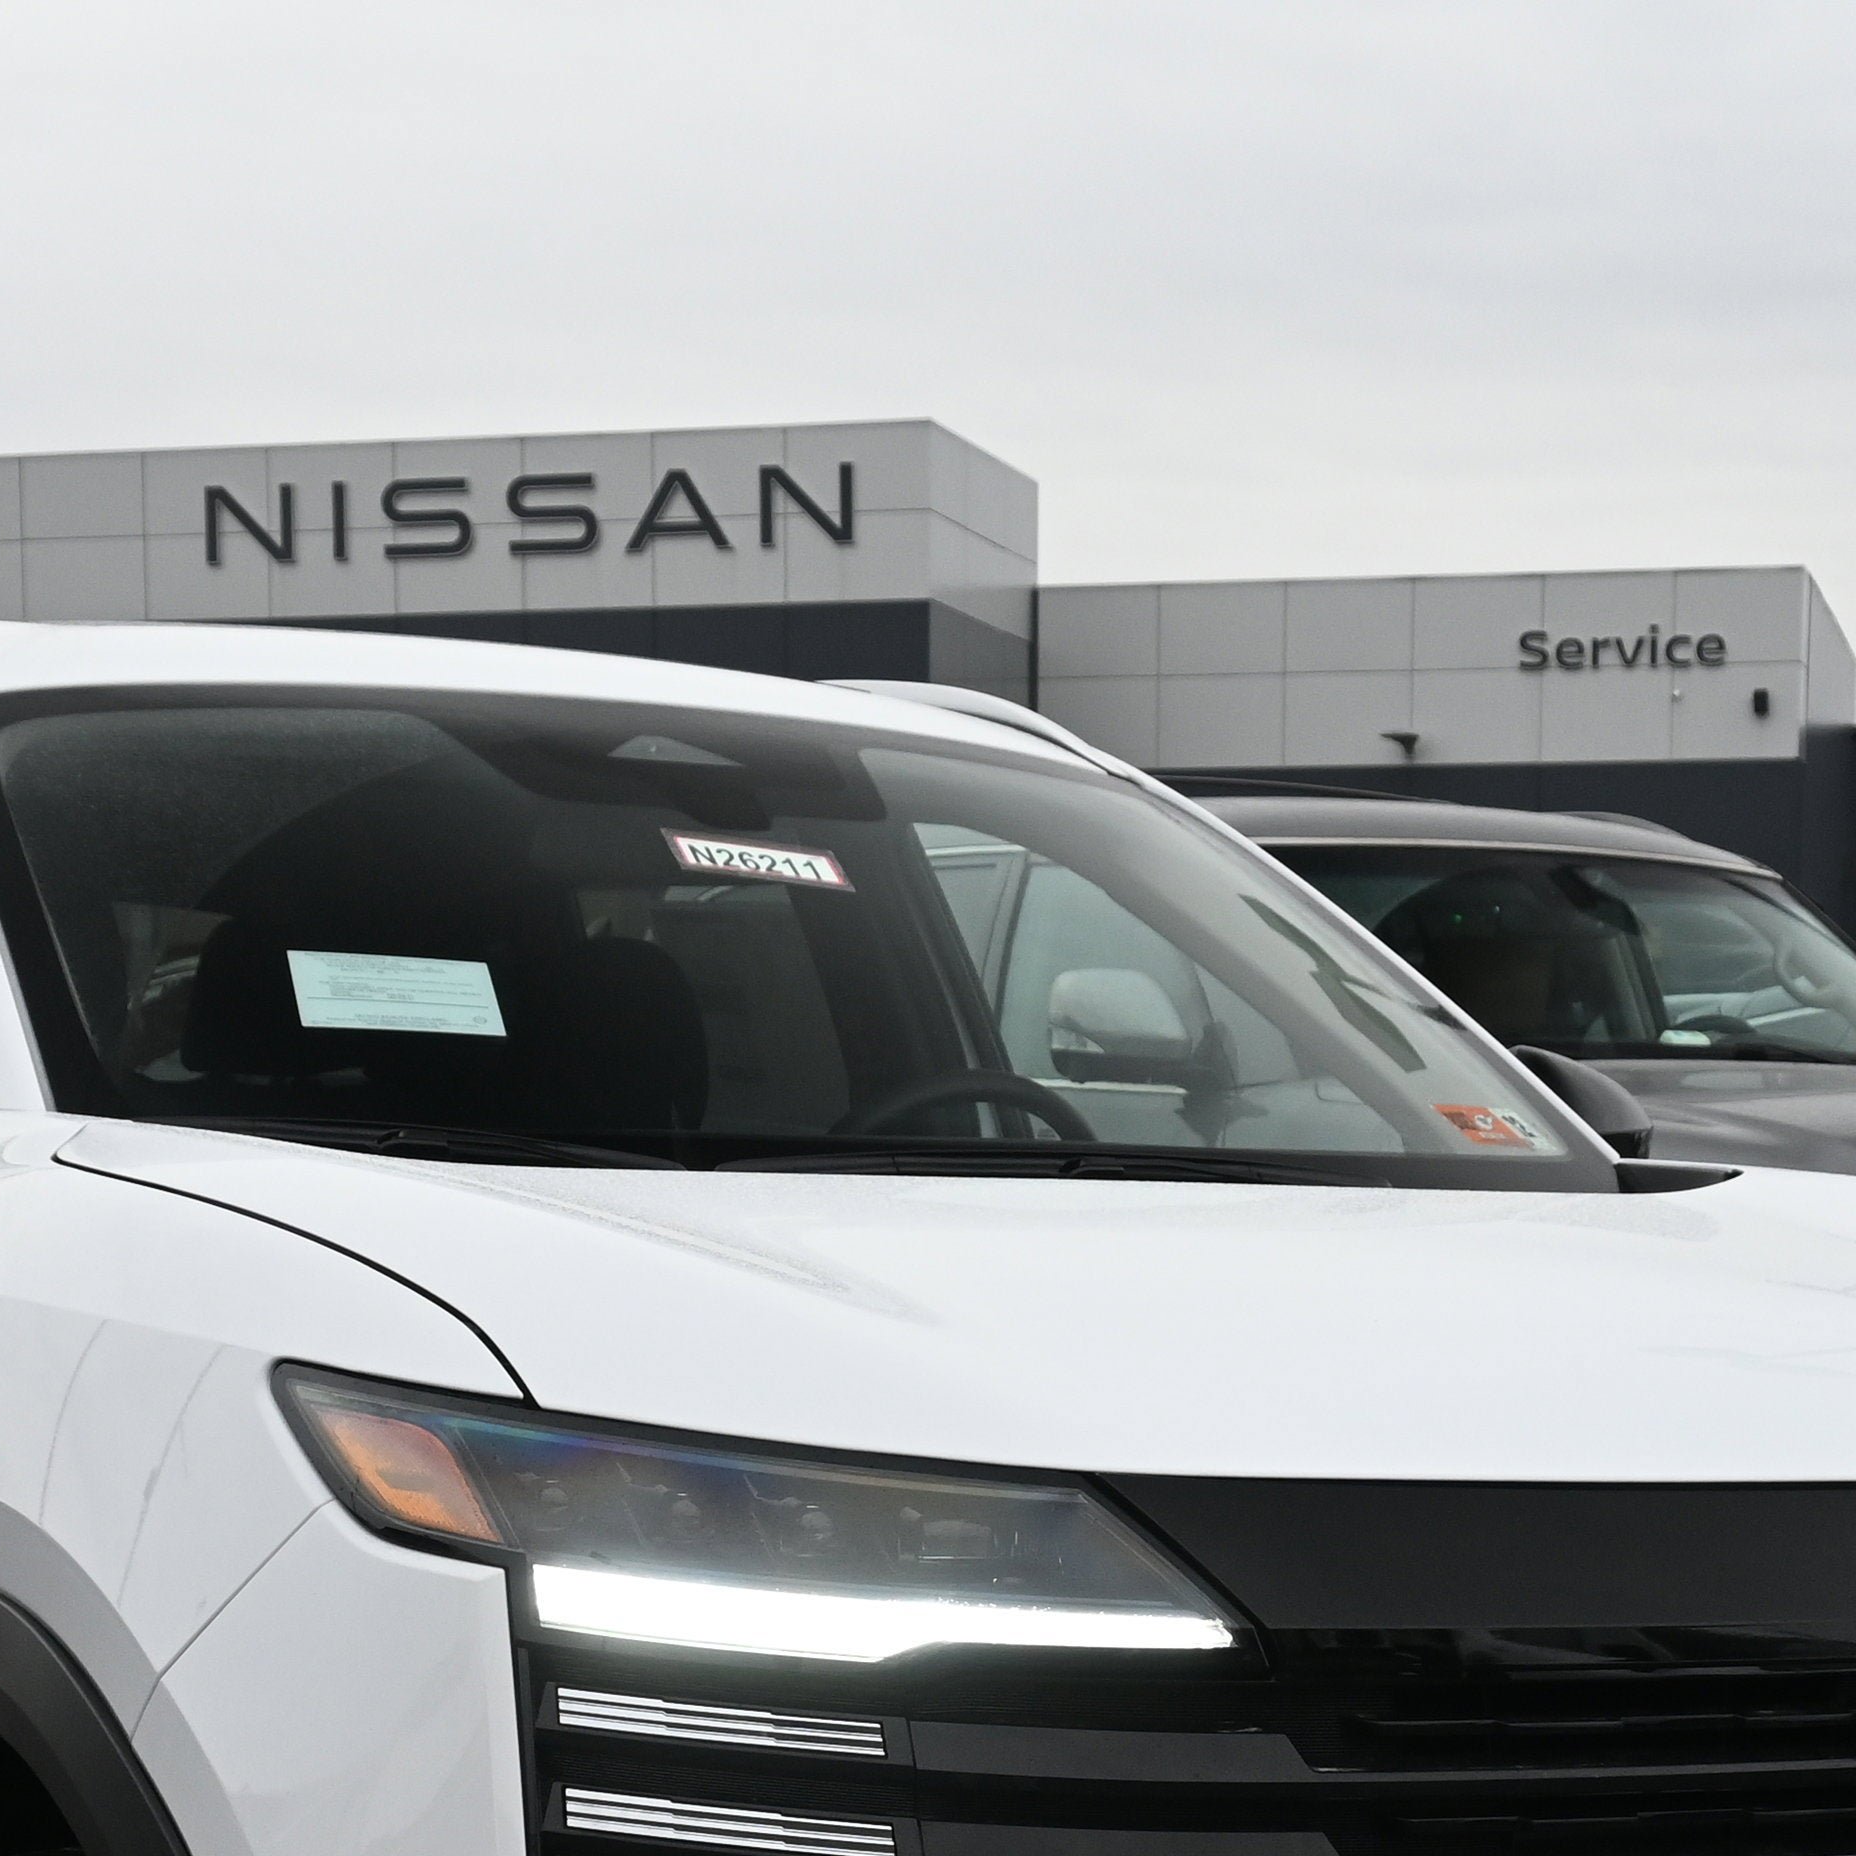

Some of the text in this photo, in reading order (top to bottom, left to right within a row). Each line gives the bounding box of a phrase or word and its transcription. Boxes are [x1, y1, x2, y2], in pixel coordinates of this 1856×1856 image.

[203, 461, 856, 565] NISSAN
[1518, 623, 1727, 671] Service
[687, 843, 822, 880] N26211
